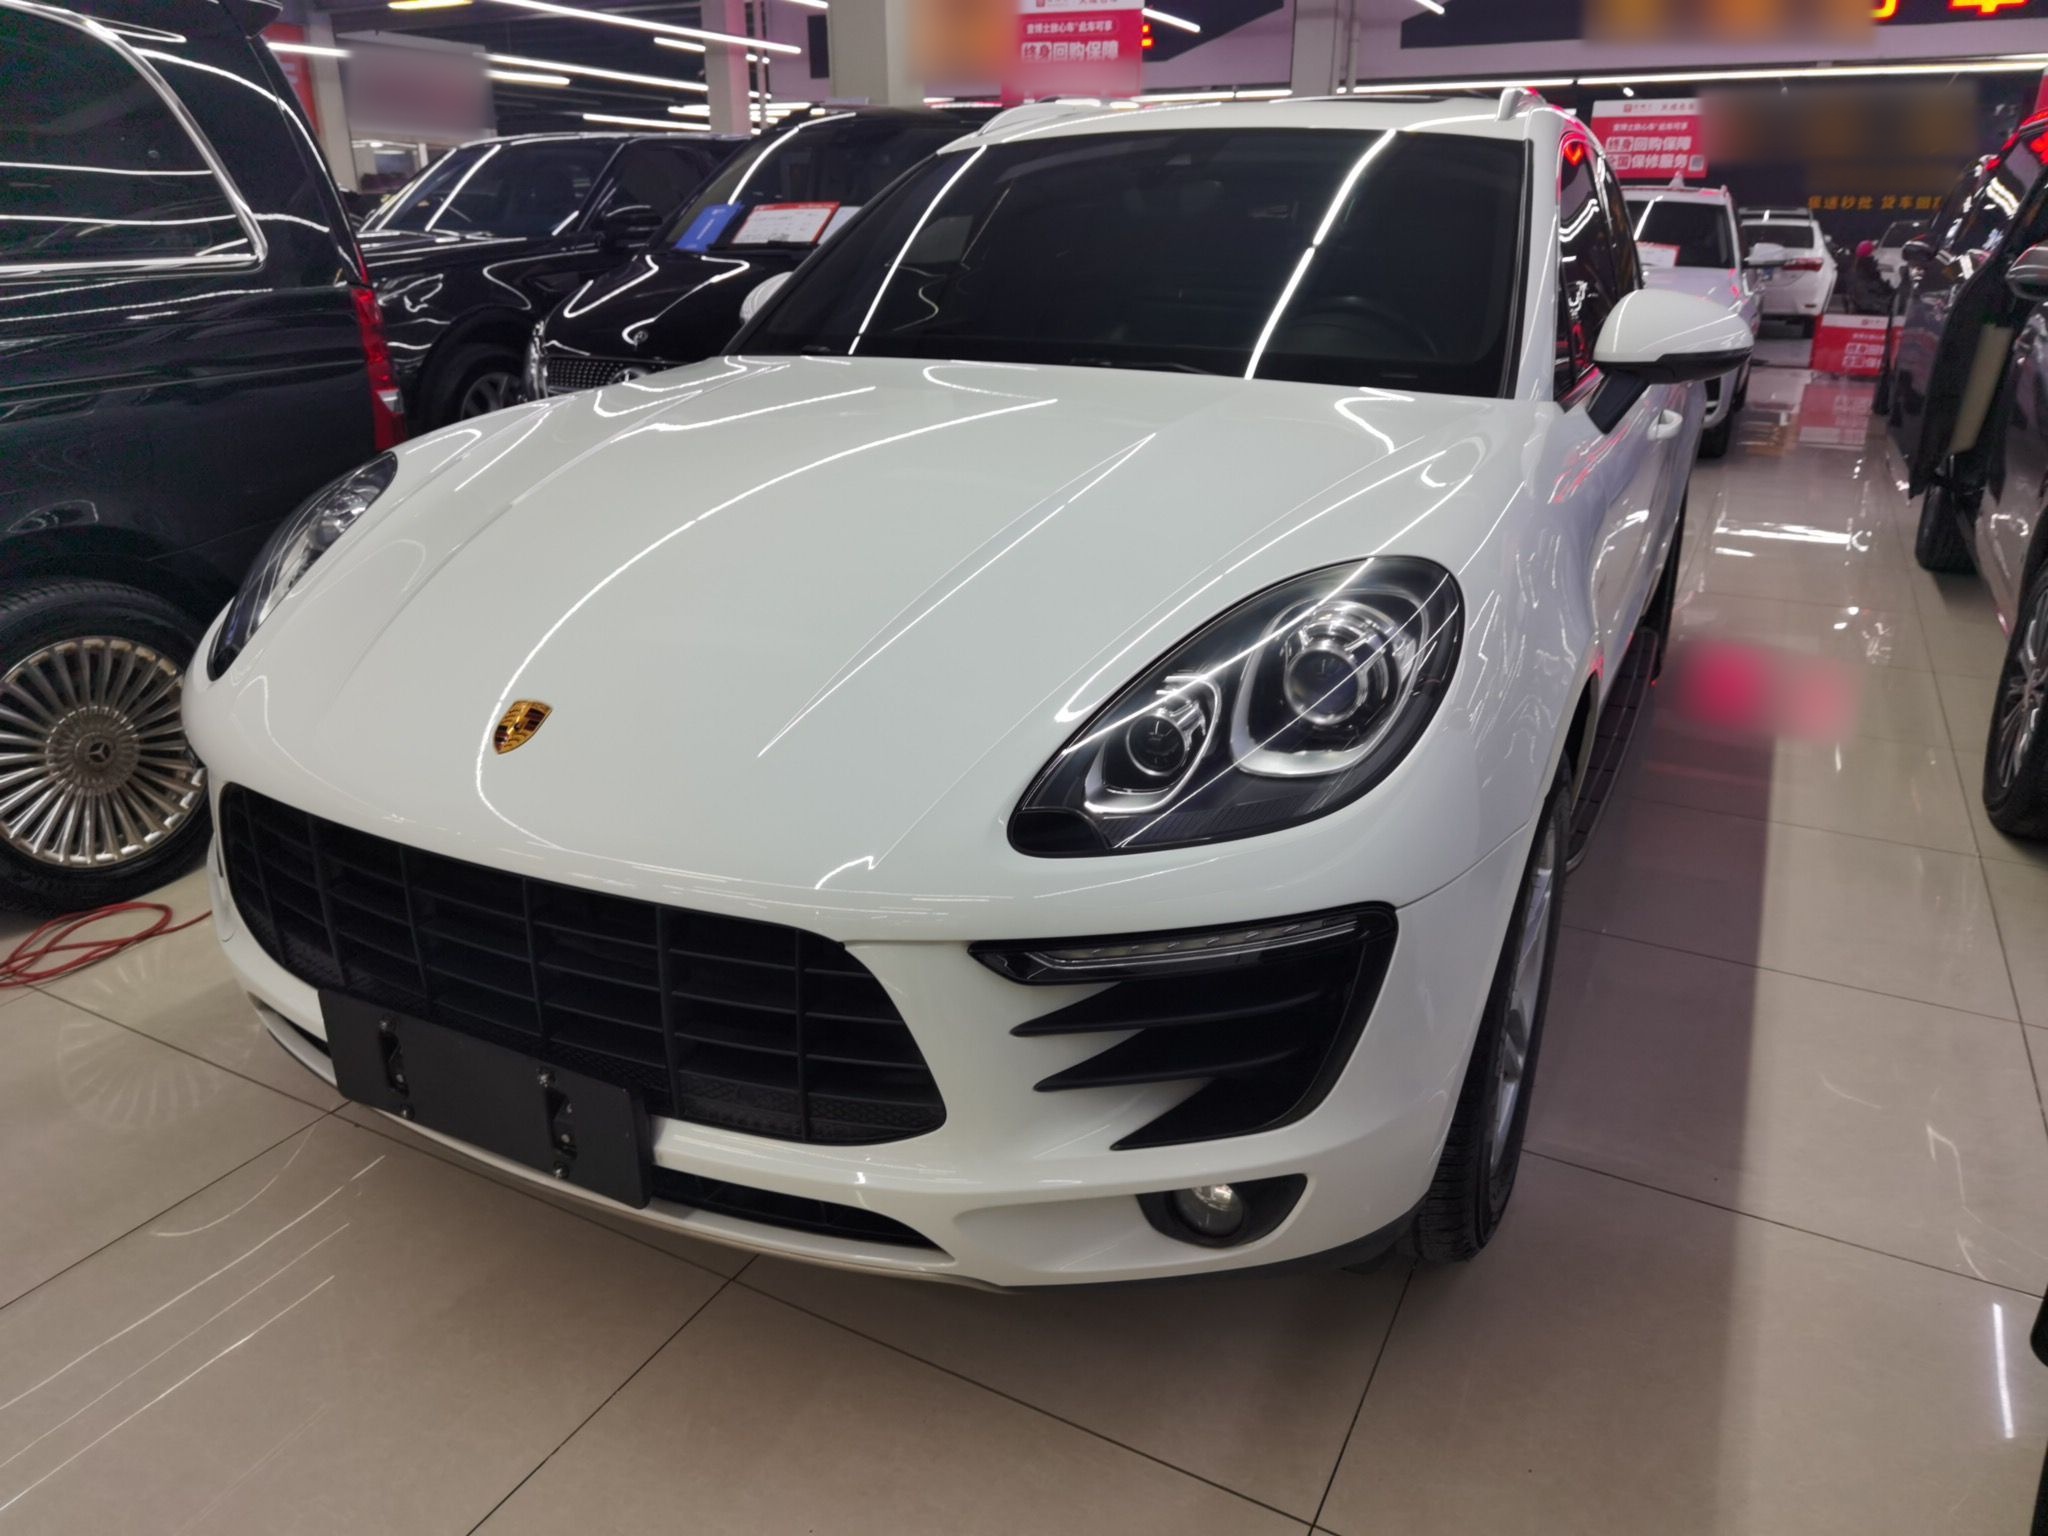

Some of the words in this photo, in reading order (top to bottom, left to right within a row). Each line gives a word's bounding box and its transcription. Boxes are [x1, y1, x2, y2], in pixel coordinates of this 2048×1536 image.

[1022, 40, 1119, 61] 终身回购保障
